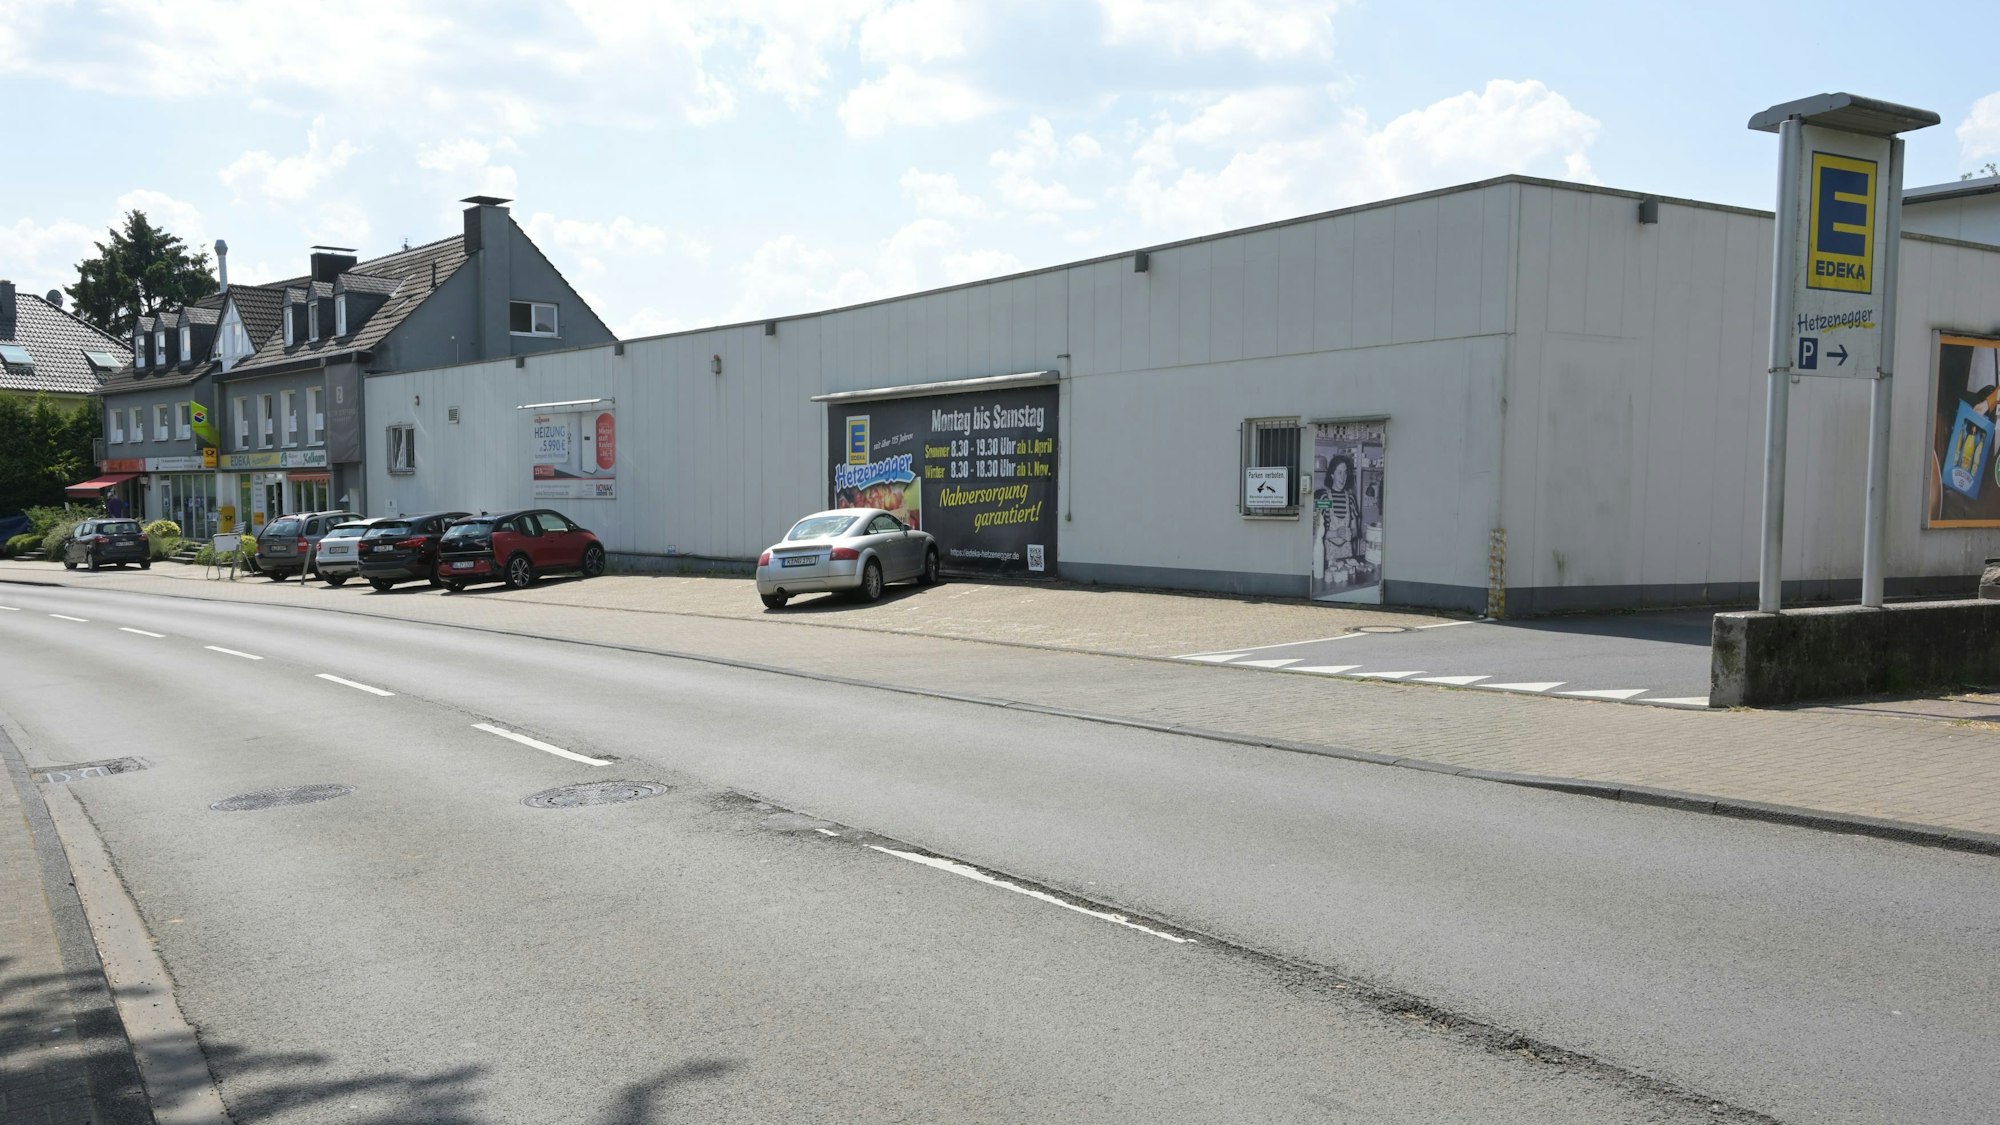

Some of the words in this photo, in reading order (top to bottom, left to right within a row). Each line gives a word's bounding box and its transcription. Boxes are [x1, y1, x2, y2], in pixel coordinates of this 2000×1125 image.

[1815, 260, 1866, 280] EDEKA
[1797, 309, 1873, 333] Hetzenegger
[1802, 341, 1814, 366] P
[931, 408, 972, 436] Montag
[973, 405, 991, 430] bis
[993, 404, 1045, 433] Samstag
[534, 425, 566, 439] HEIZUNG
[543, 440, 561, 452] 5.990
[924, 444, 950, 459] Sommer
[950, 439, 969, 458] 8.30
[976, 437, 999, 456] 19.30
[1000, 437, 1017, 456] Uhr
[1017, 441, 1026, 455] ab
[1034, 438, 1053, 457] April
[230, 455, 250, 466] EDEKA
[924, 464, 946, 479] Winter
[950, 460, 969, 479] 8.30
[976, 459, 999, 478] 18.30
[1000, 459, 1017, 478] Uhr
[1017, 461, 1026, 477] ab
[1034, 460, 1052, 478] Nov.
[836, 455, 912, 491] Hetzenegger
[1248, 471, 1263, 479] Parken
[939, 484, 1029, 508] Nahversorgung
[974, 500, 1042, 534] garantiert!
